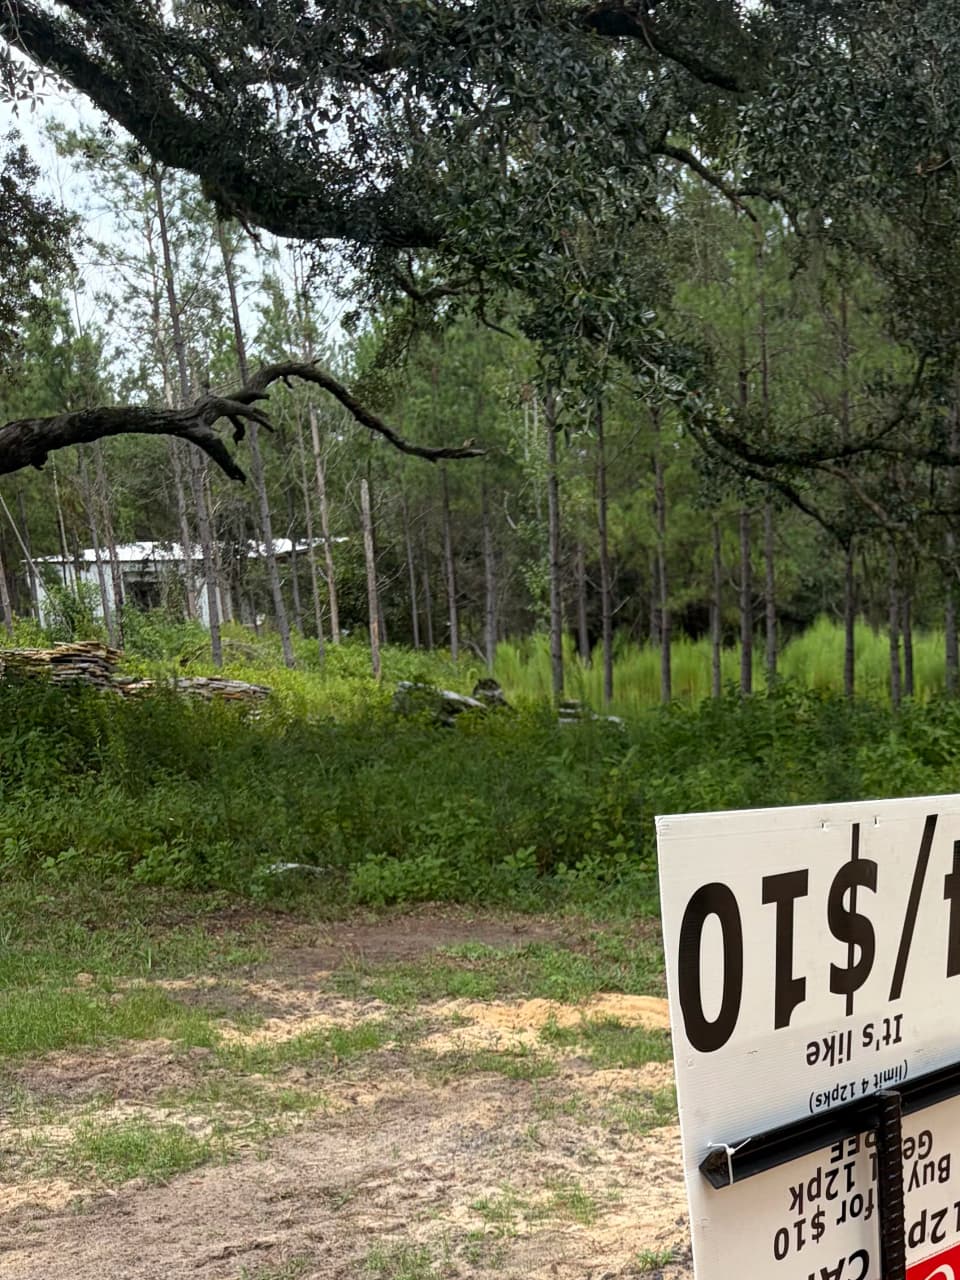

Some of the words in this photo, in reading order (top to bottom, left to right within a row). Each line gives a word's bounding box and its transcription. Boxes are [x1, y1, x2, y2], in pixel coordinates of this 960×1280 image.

[806, 1030, 852, 1066] like
[863, 1014, 903, 1050] It's
[861, 1078, 869, 1094] 4
[874, 1060, 908, 1089] (limit
[809, 1081, 856, 1113] 12pks)
[903, 1130, 933, 1160] Ge
[789, 1161, 855, 1214] 12pk
[908, 1153, 951, 1193] Buy
[836, 1188, 875, 1226] for
[773, 1205, 826, 1261] $10
